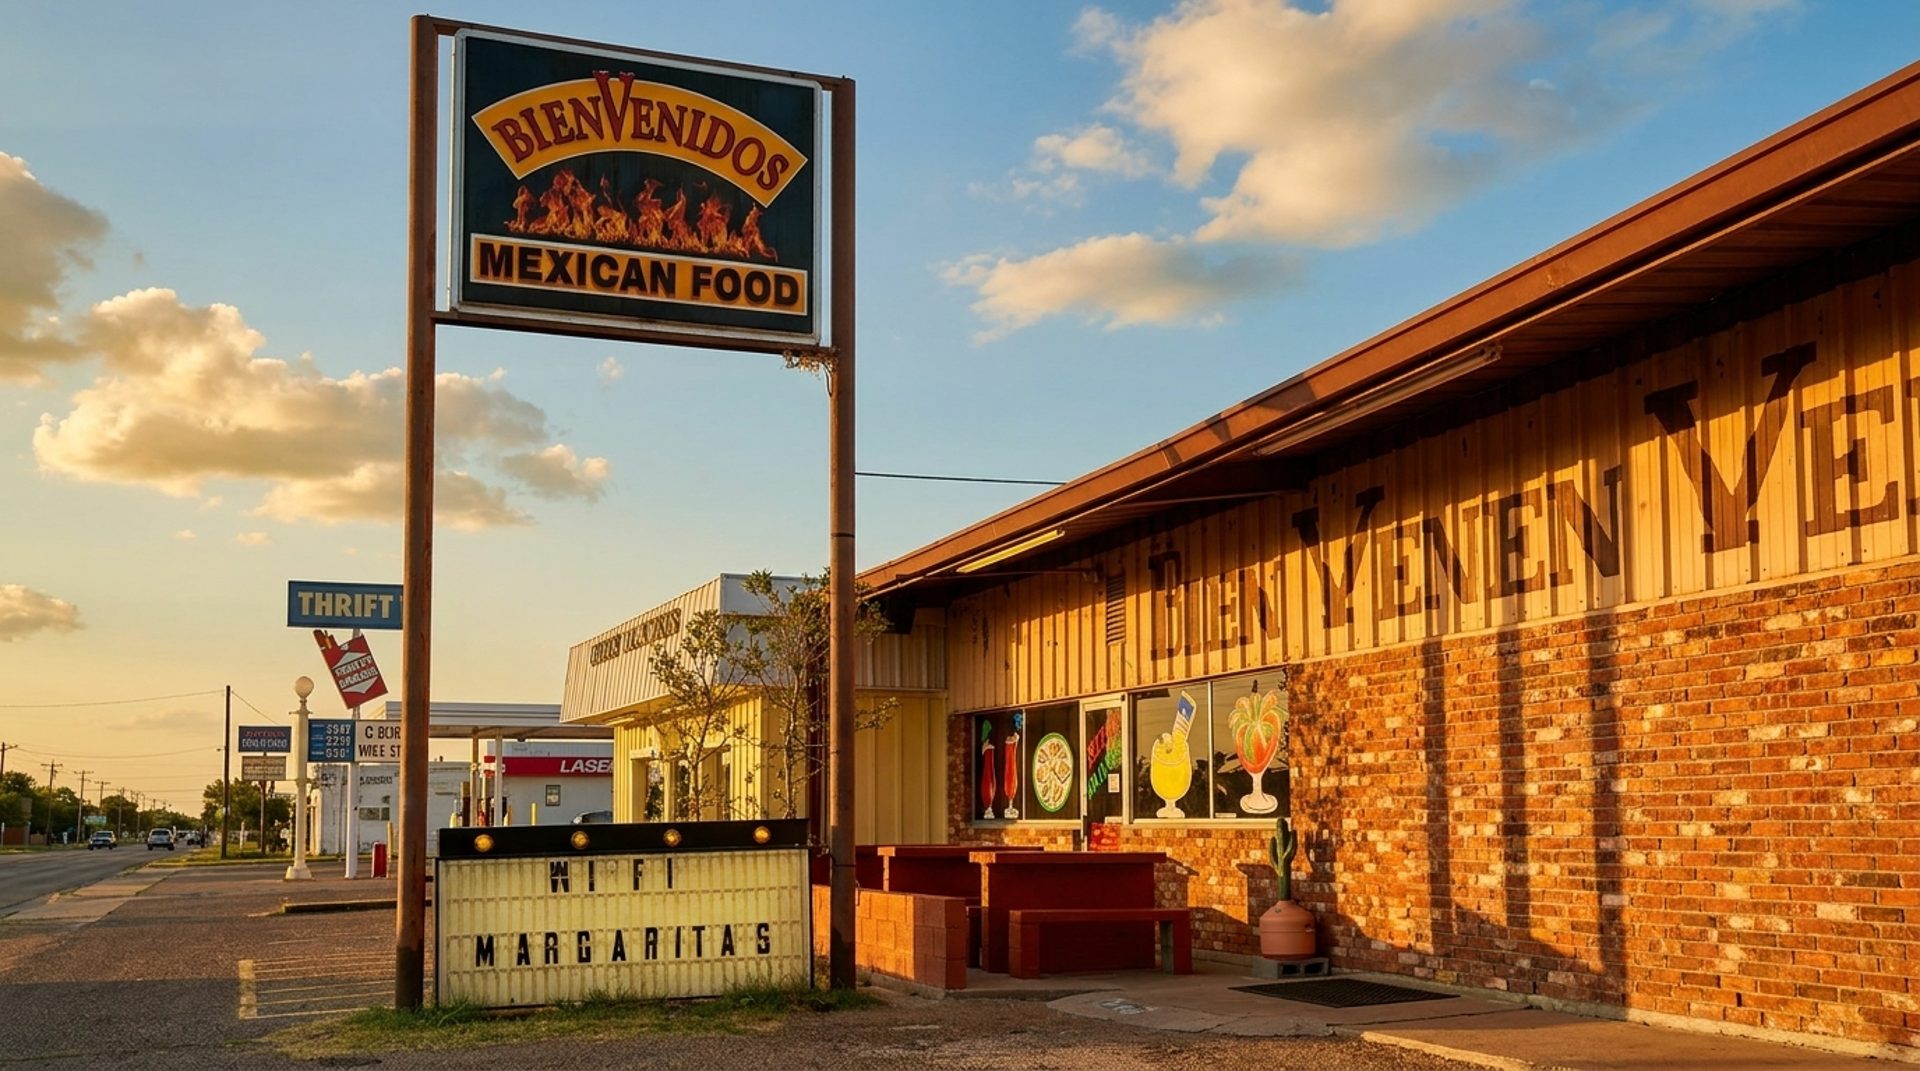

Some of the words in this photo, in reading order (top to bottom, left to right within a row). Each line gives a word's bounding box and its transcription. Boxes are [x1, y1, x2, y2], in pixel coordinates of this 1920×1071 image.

[479, 242, 677, 297] MEXICAN
[691, 265, 800, 306] FOOD
[298, 591, 394, 619] THRIFT
[560, 759, 613, 774] LASE
[475, 922, 771, 967] MARGARITAS
